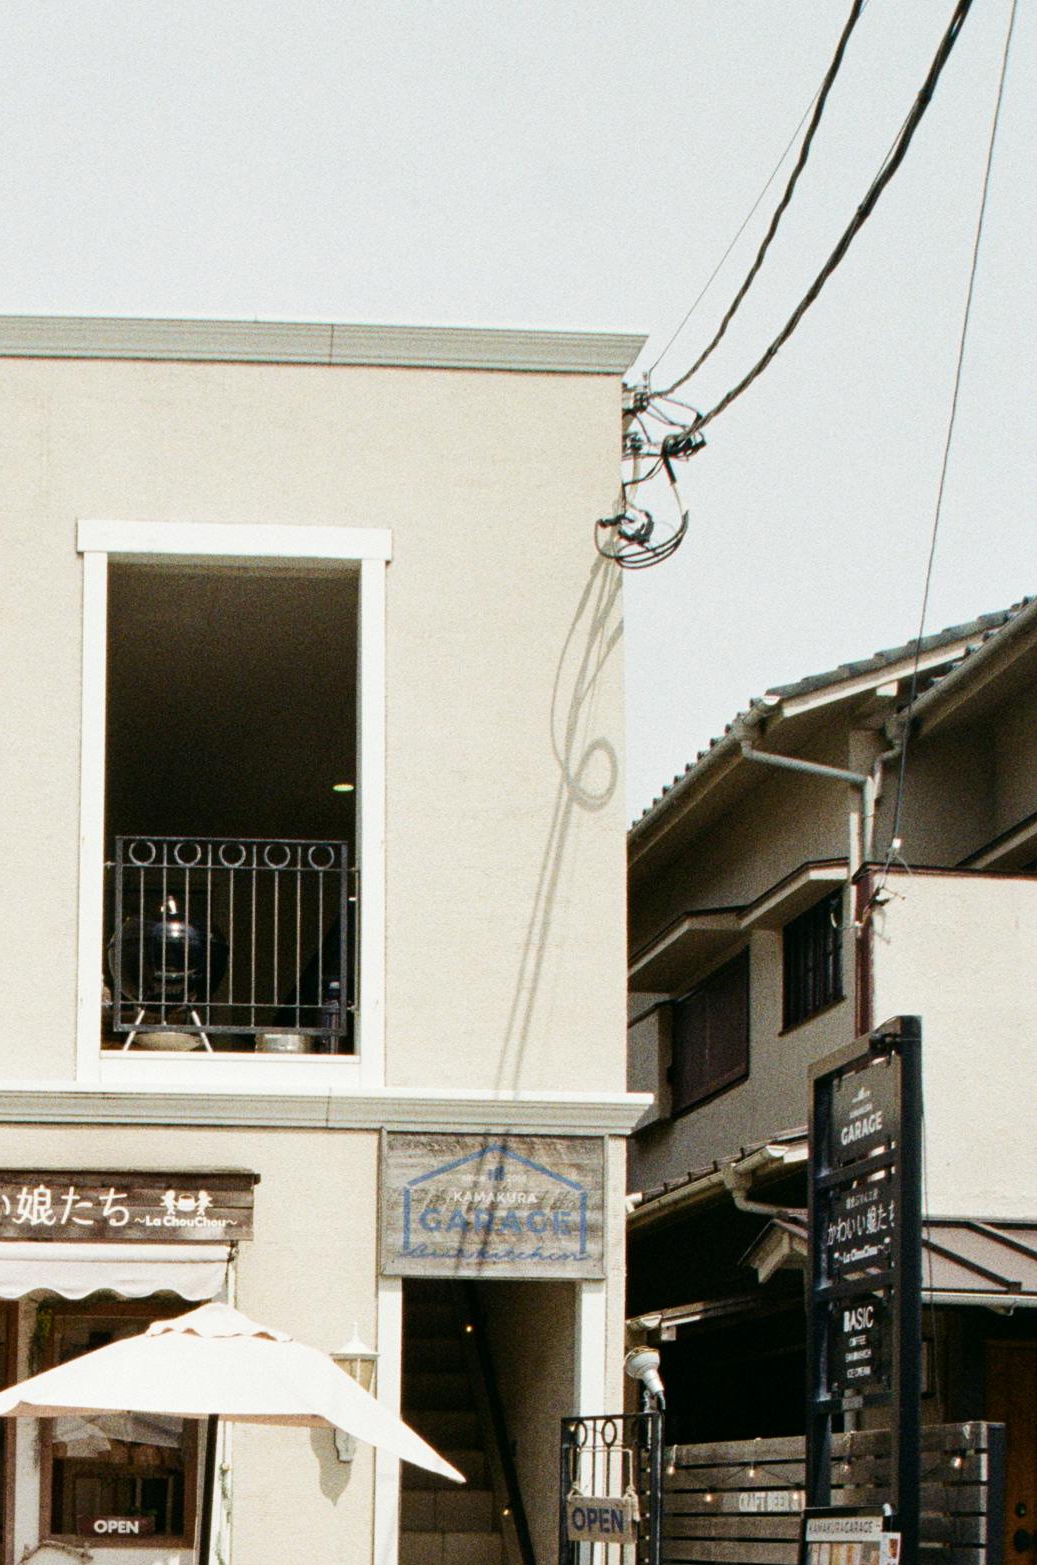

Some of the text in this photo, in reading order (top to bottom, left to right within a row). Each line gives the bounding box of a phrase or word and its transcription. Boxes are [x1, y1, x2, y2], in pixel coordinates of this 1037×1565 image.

[841, 1111, 883, 1146] GARAGE
[452, 1190, 539, 1205] KAMAKURA
[418, 1206, 573, 1236] GARAGE
[843, 1306, 875, 1333] BASIC
[93, 1519, 140, 1535] OPEN
[571, 1507, 625, 1534] OPEN
